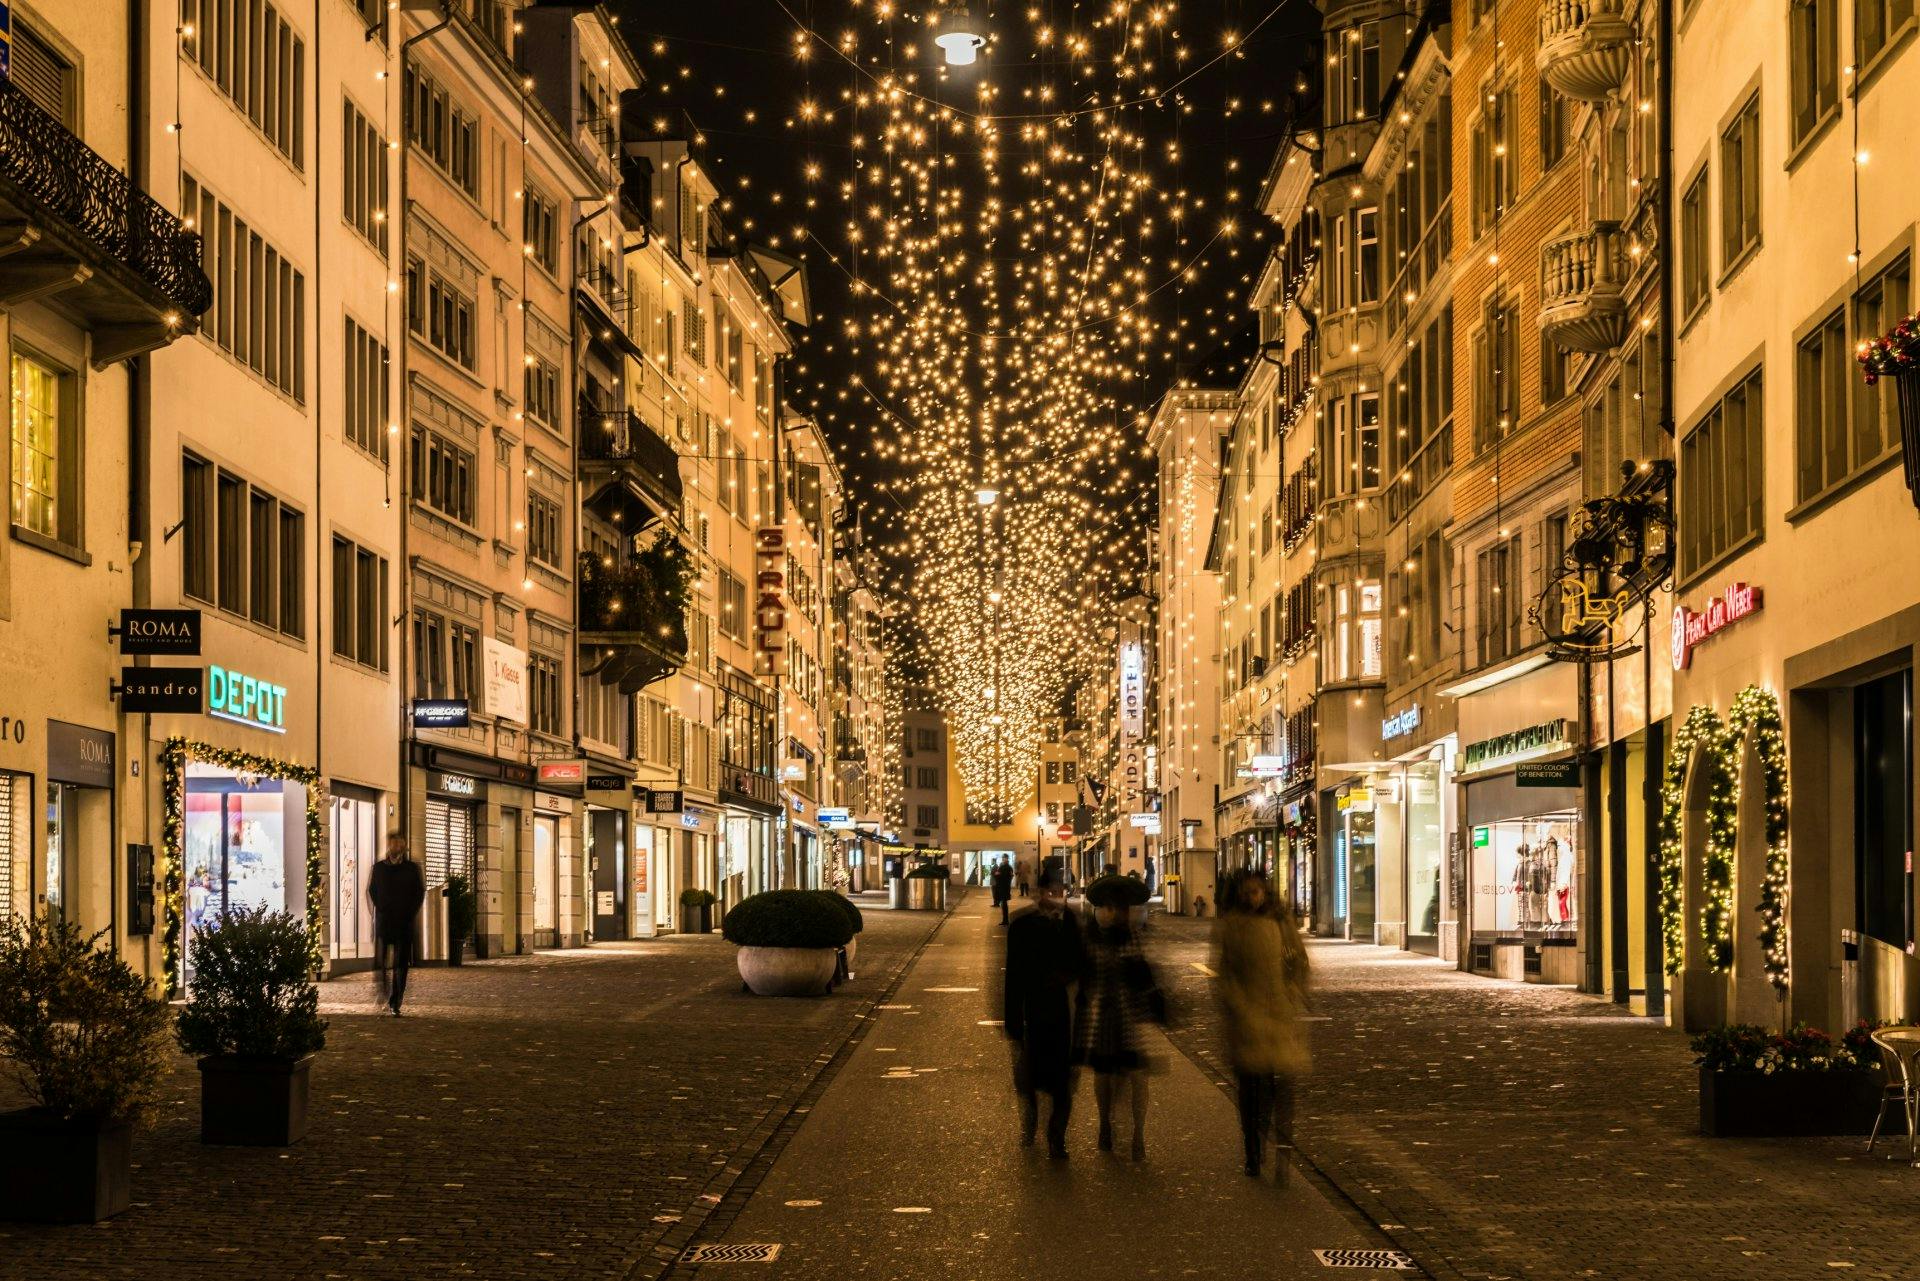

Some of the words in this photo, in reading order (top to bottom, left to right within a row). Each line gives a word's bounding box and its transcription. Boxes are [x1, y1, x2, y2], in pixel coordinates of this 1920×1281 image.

[1685, 612, 1708, 646] FRANZ
[1707, 596, 1726, 633] CARL
[1725, 583, 1754, 622] WEBER
[129, 620, 191, 637] ROMA
[502, 663, 520, 685] Klasse
[126, 682, 198, 696] sandro
[209, 664, 288, 726] DEPOT
[80, 738, 111, 765] ROMA
[591, 778, 620, 789] maje
